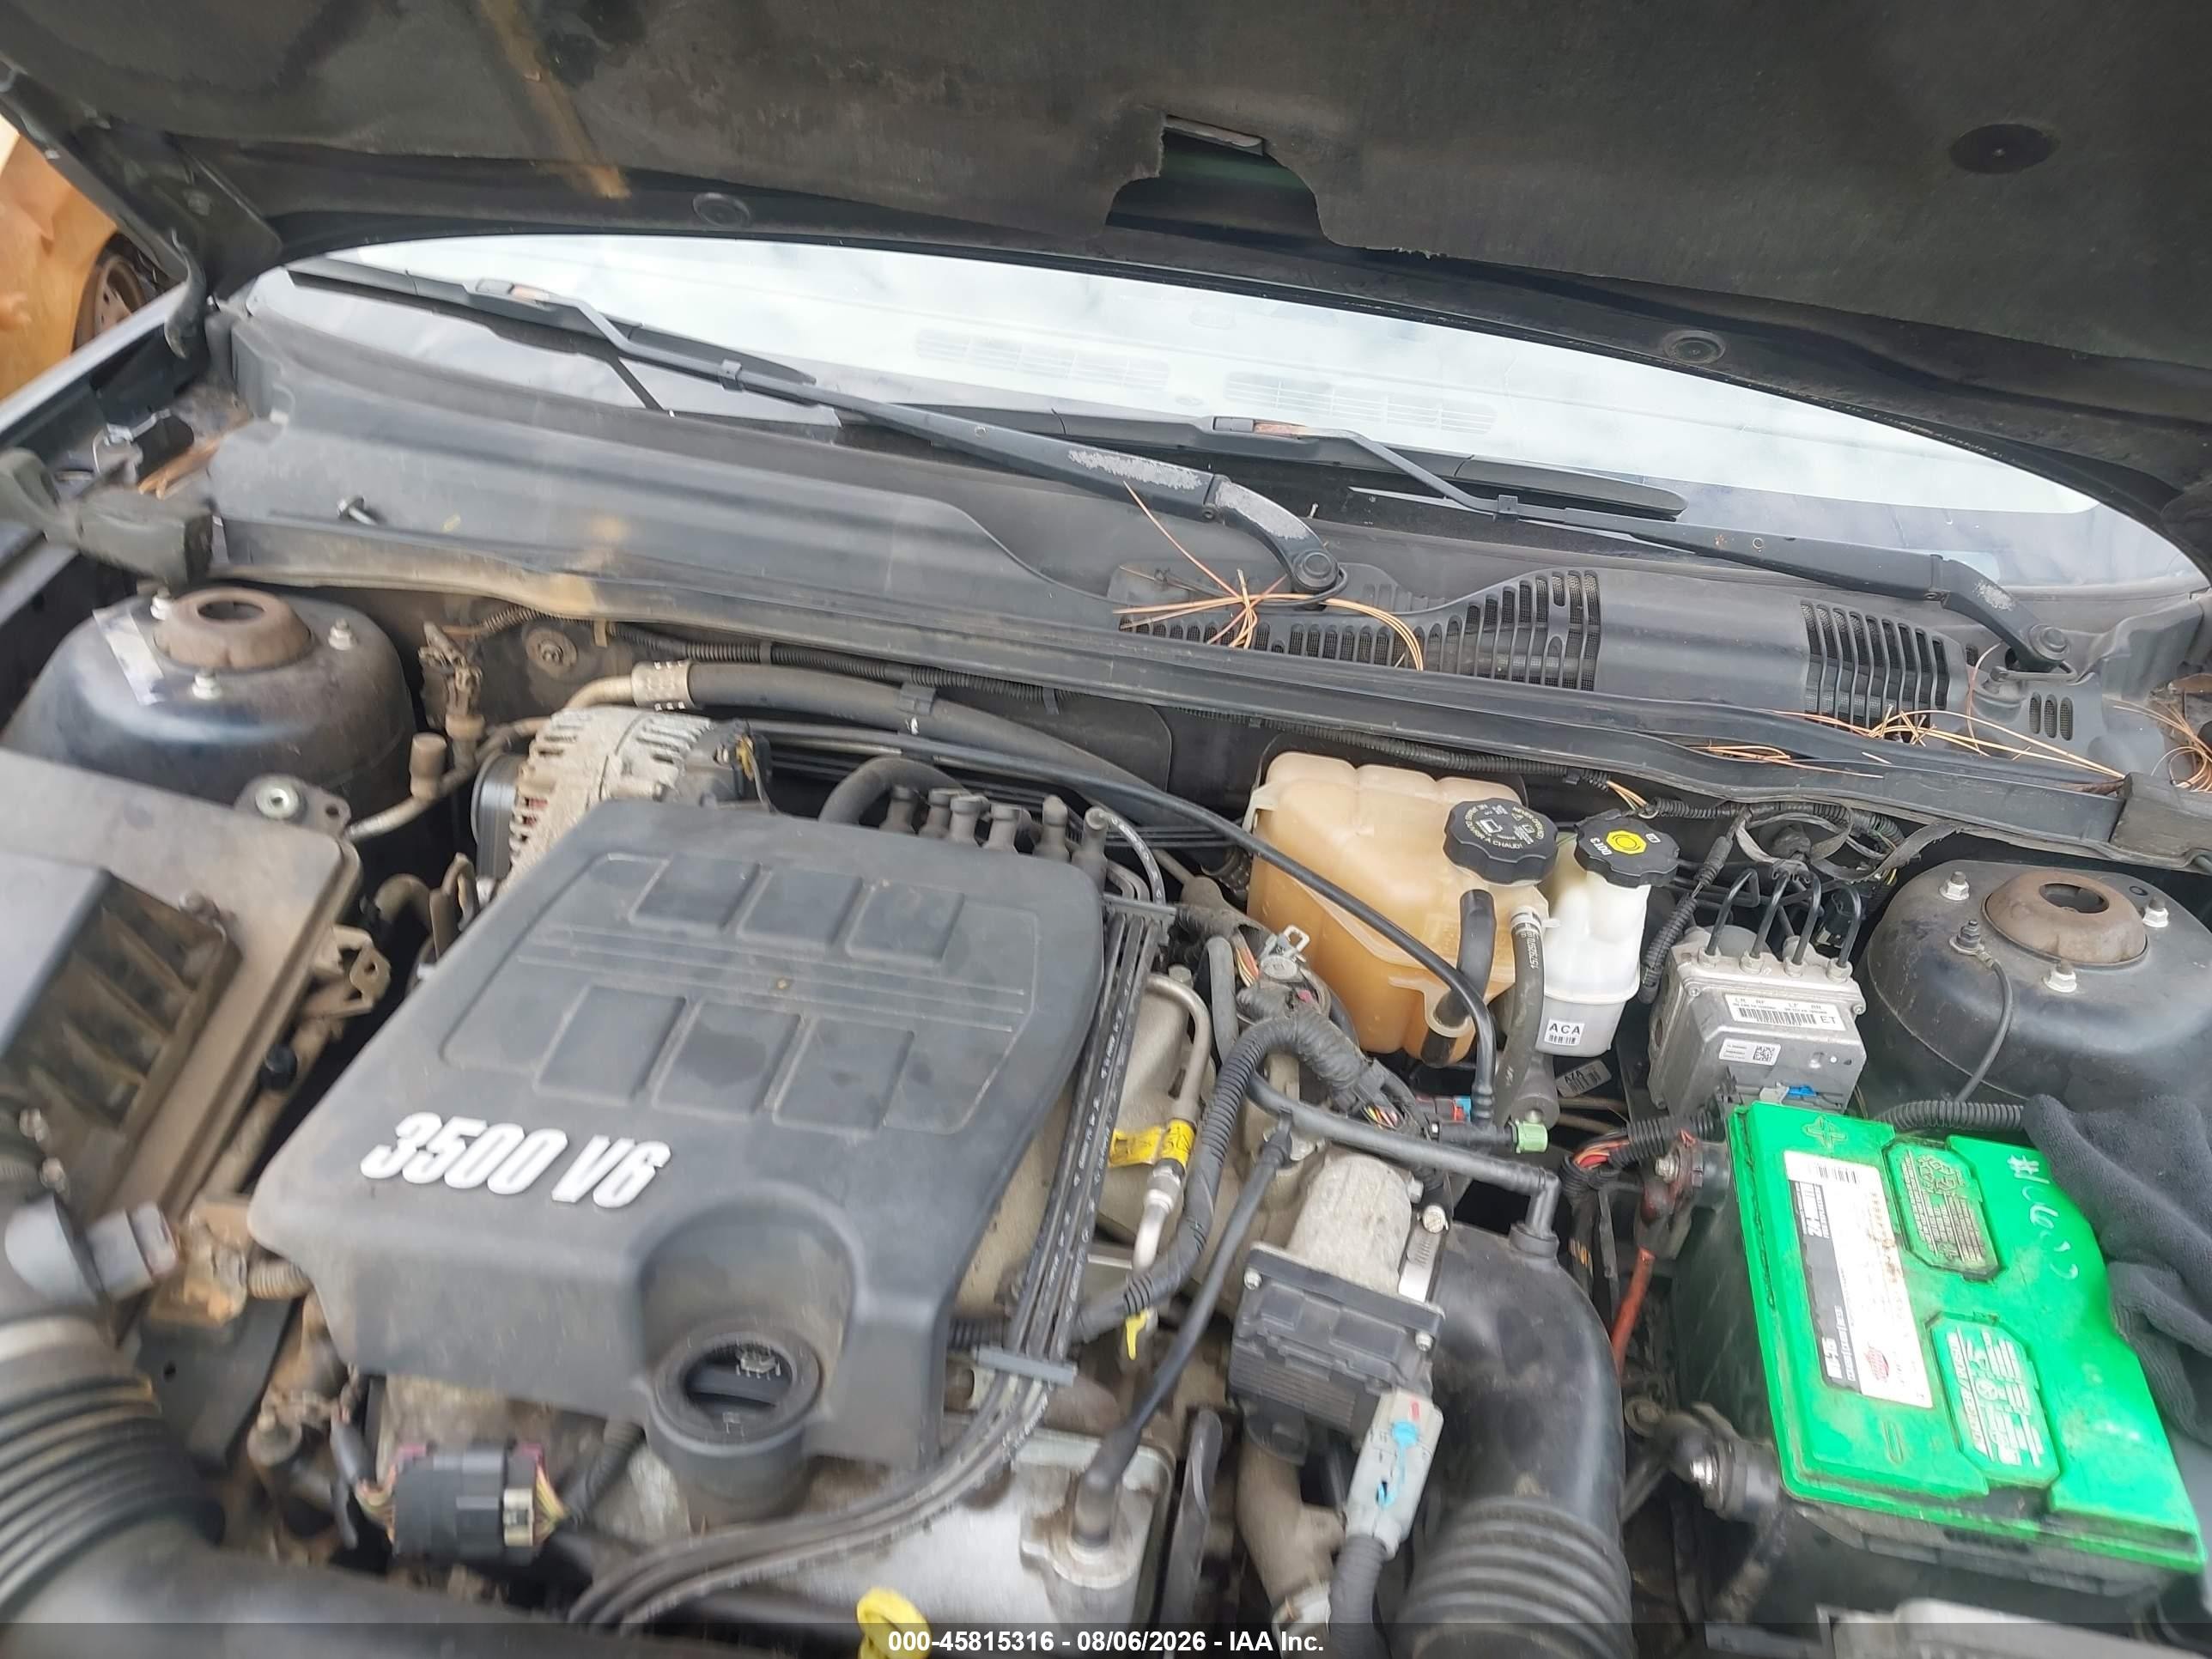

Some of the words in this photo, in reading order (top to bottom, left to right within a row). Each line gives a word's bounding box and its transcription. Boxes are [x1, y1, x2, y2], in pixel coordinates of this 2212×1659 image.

[1820, 1015, 1836, 1024] ET
[1549, 1023, 1582, 1035] ACA
[360, 1111, 569, 1195] 3500
[551, 1134, 672, 1210] V6
